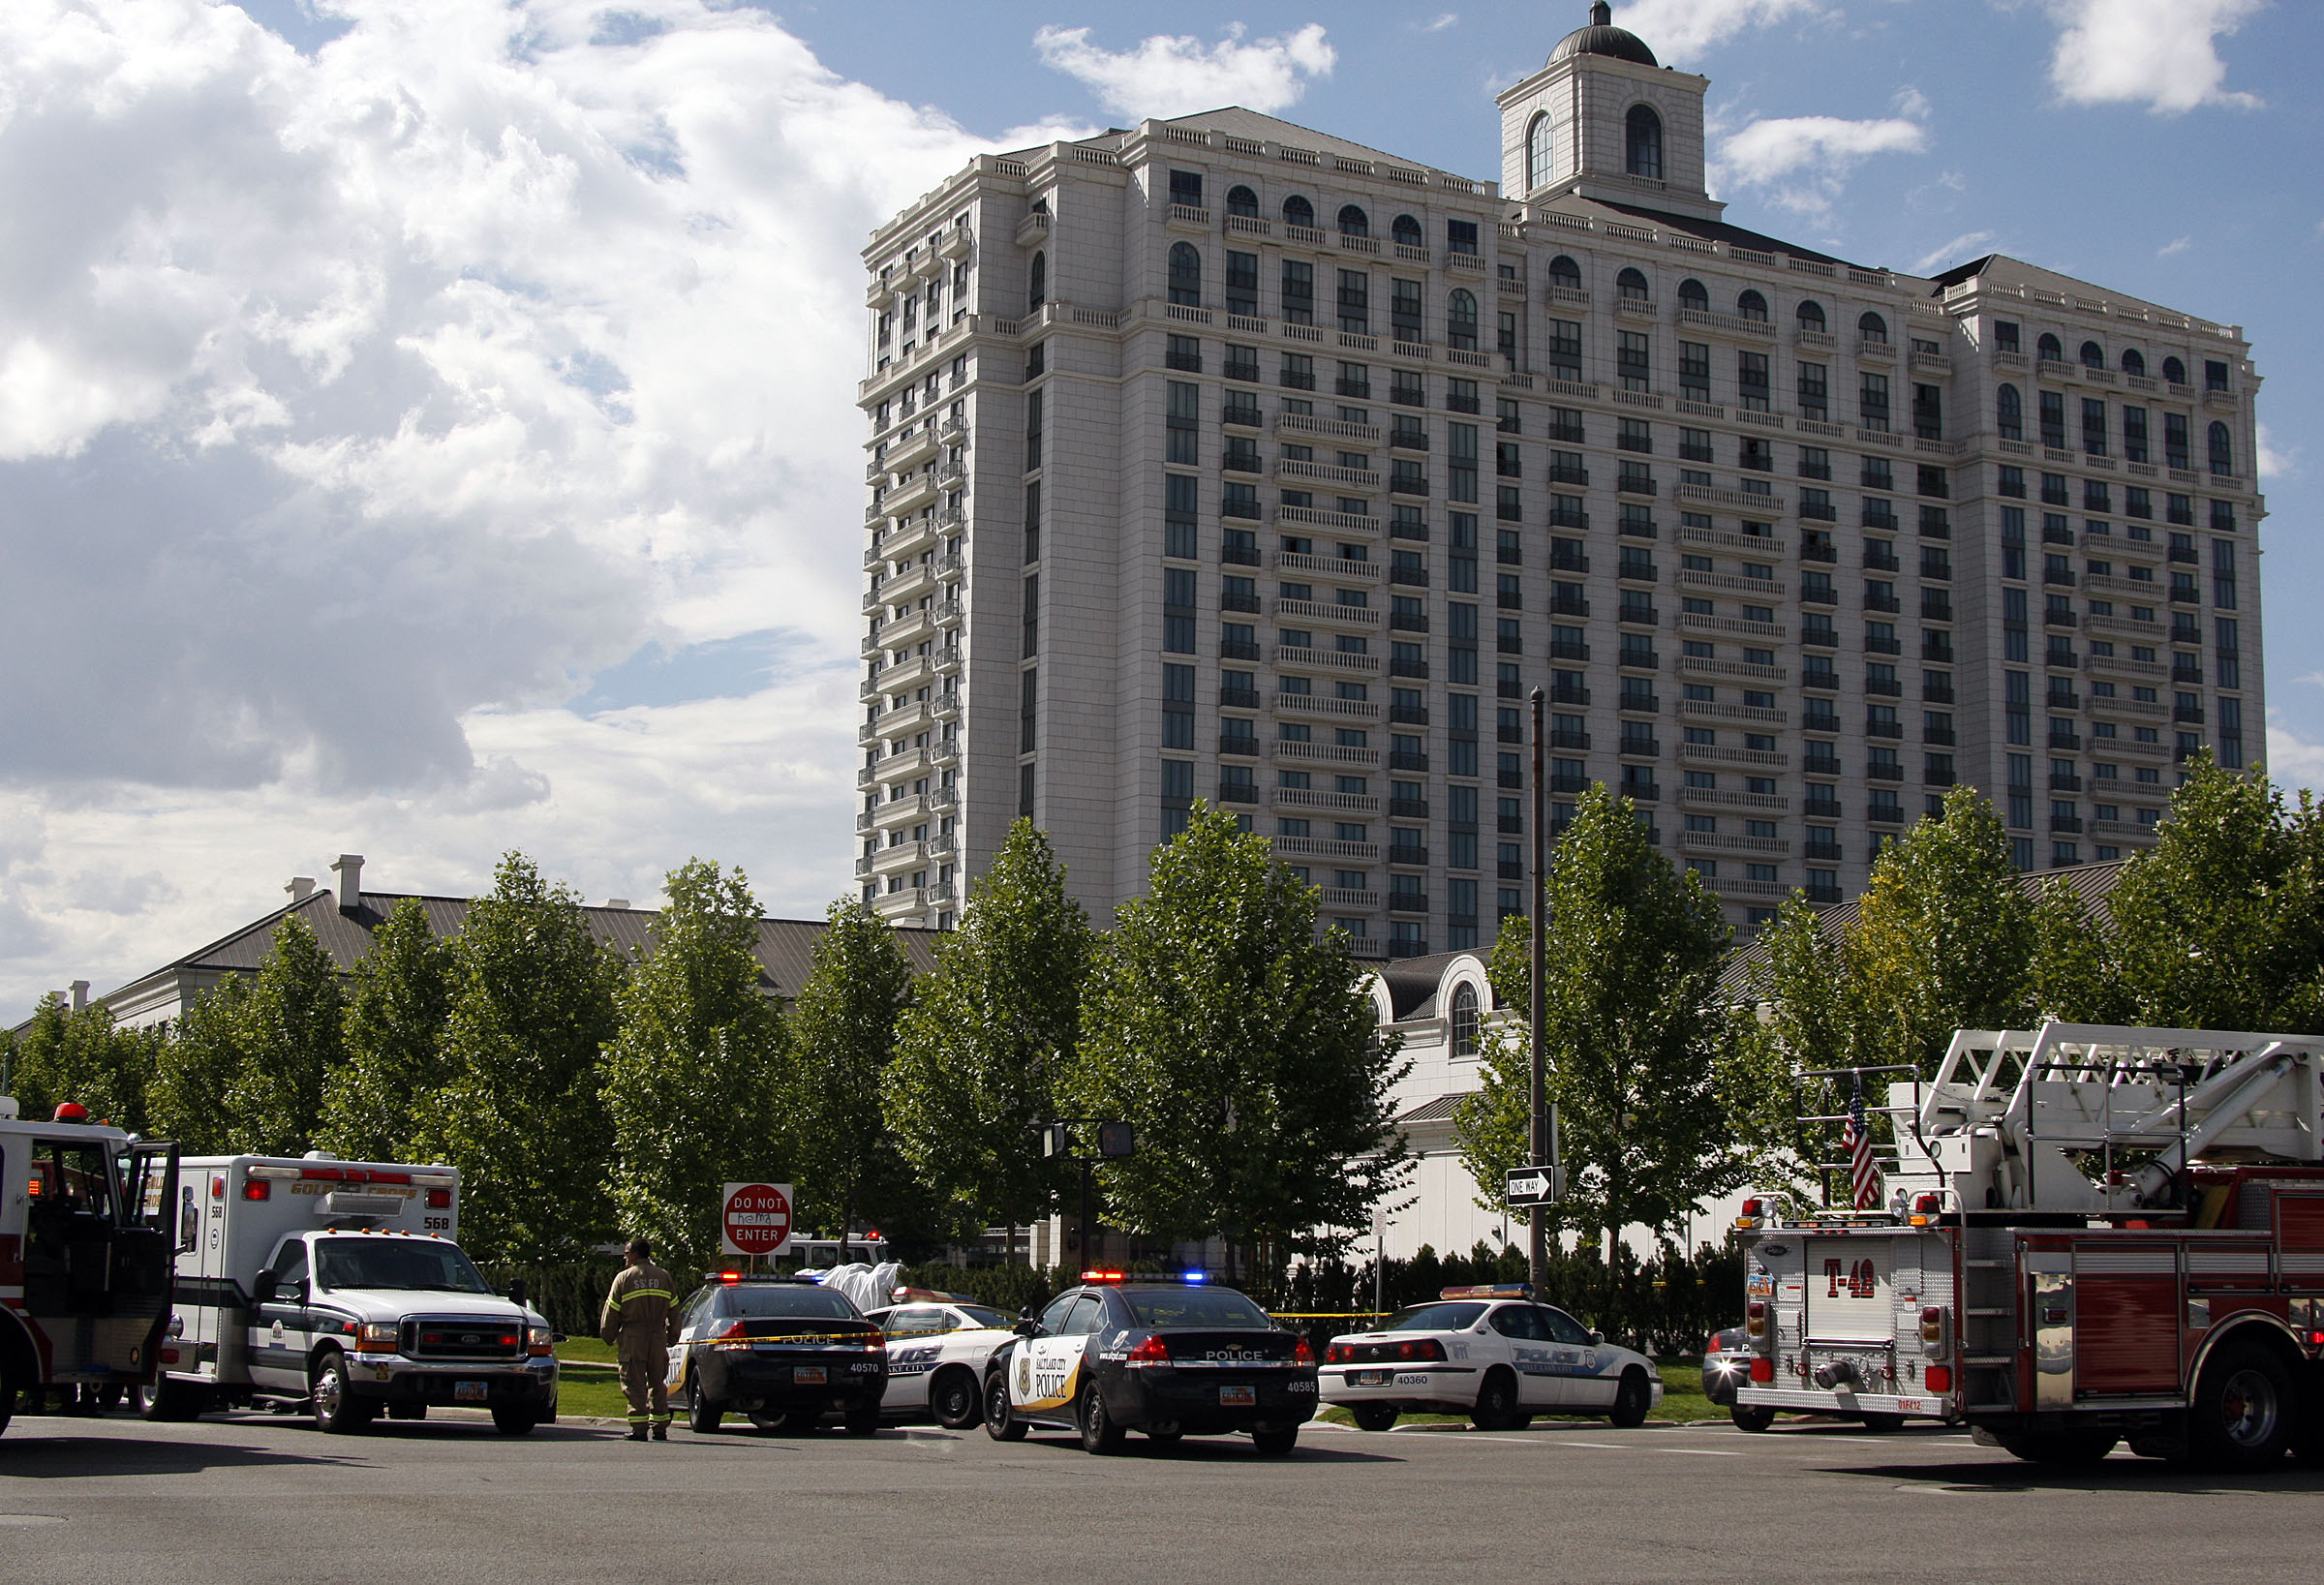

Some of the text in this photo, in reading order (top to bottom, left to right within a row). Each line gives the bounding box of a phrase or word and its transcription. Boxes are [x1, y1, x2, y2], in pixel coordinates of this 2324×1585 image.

[291, 1183, 334, 1196] GOLD
[1511, 1180, 1540, 1193] ONE WAY
[734, 1197, 782, 1209] DO NOT
[211, 1205, 223, 1218] 568
[424, 1217, 449, 1230] 568
[736, 1229, 779, 1241] ENTER
[1824, 1259, 1875, 1298] T-42
[1206, 1351, 1264, 1361] POLICE
[1513, 1346, 1581, 1364] POLICE
[850, 1363, 878, 1372] 40570
[1036, 1358, 1066, 1370] SALT LAKE CITY
[1036, 1374, 1066, 1398] POLICE
[1397, 1376, 1428, 1386] 40360
[1287, 1382, 1316, 1393] 40585
[1898, 1400, 1921, 1411] 01F412
